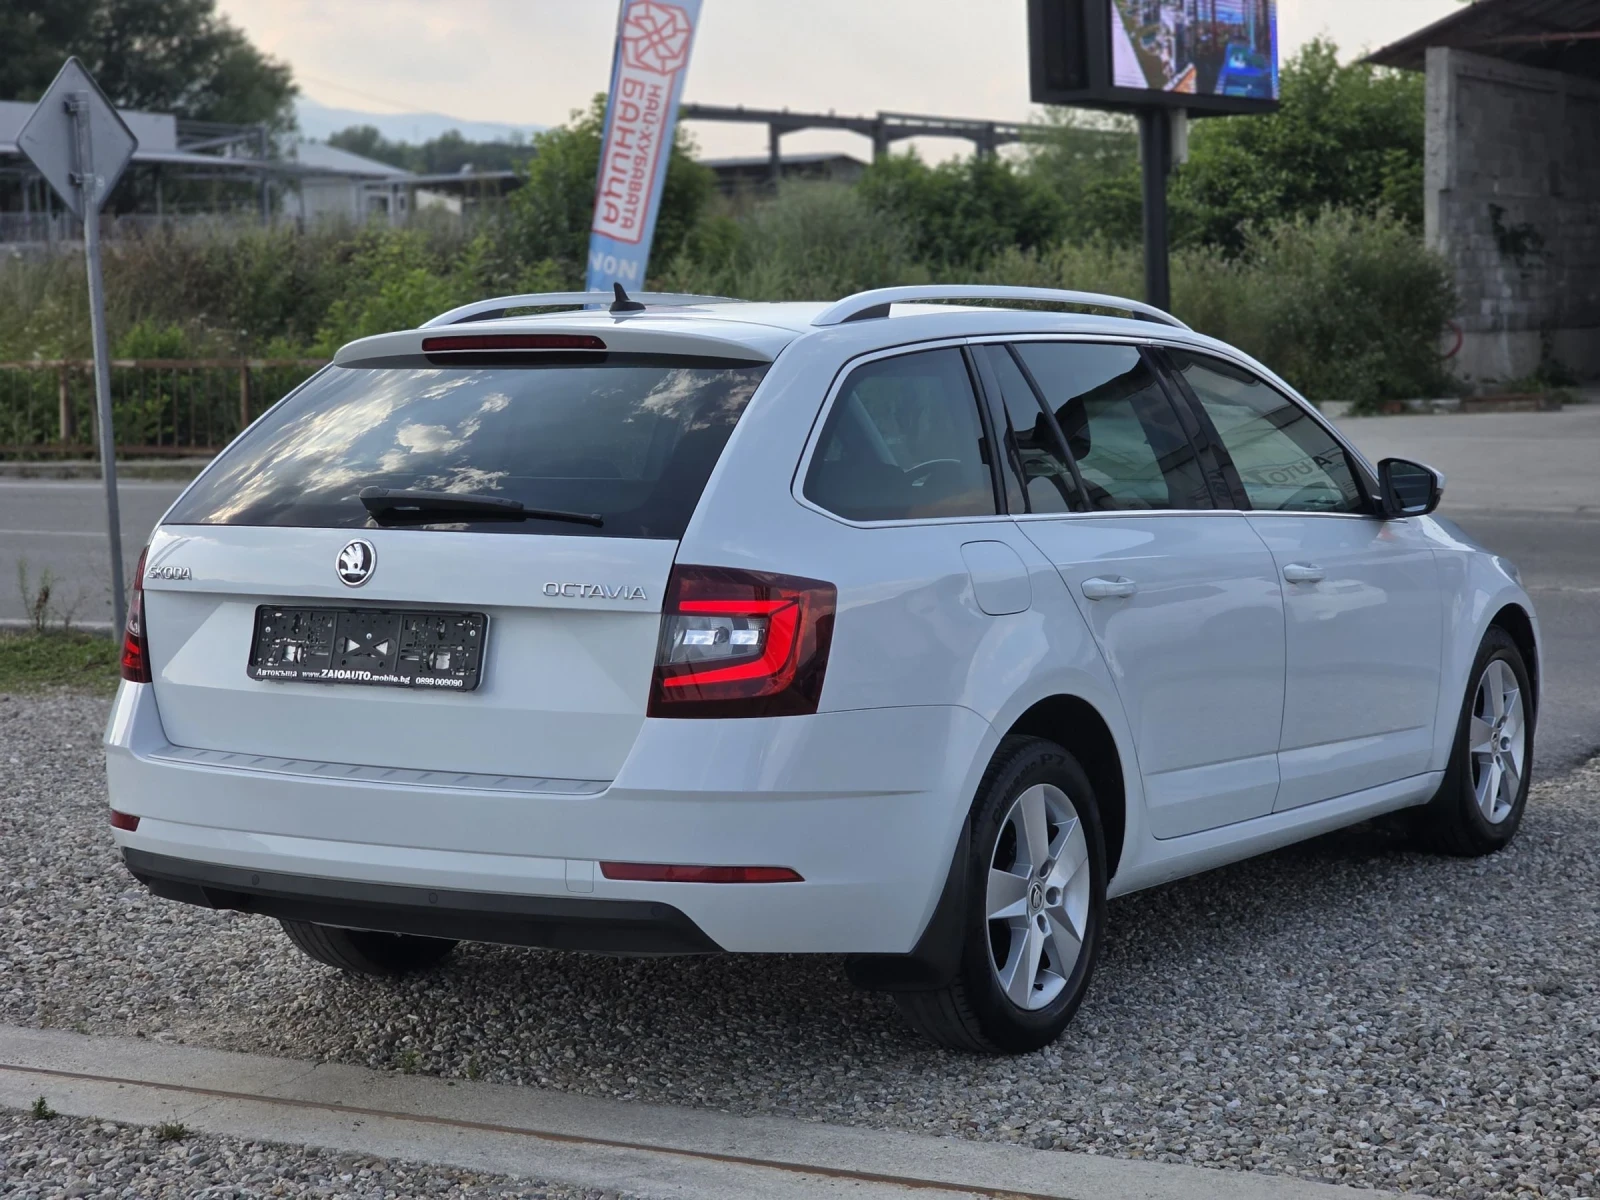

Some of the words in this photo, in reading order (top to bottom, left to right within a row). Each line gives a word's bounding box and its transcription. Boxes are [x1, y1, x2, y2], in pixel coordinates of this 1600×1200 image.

[601, 77, 645, 225] БАНИЦА
[620, 84, 662, 230] НАЙ-ХУБАВАТА
[542, 582, 648, 600] OCTAVIA
[256, 668, 297, 678] Автокъща
